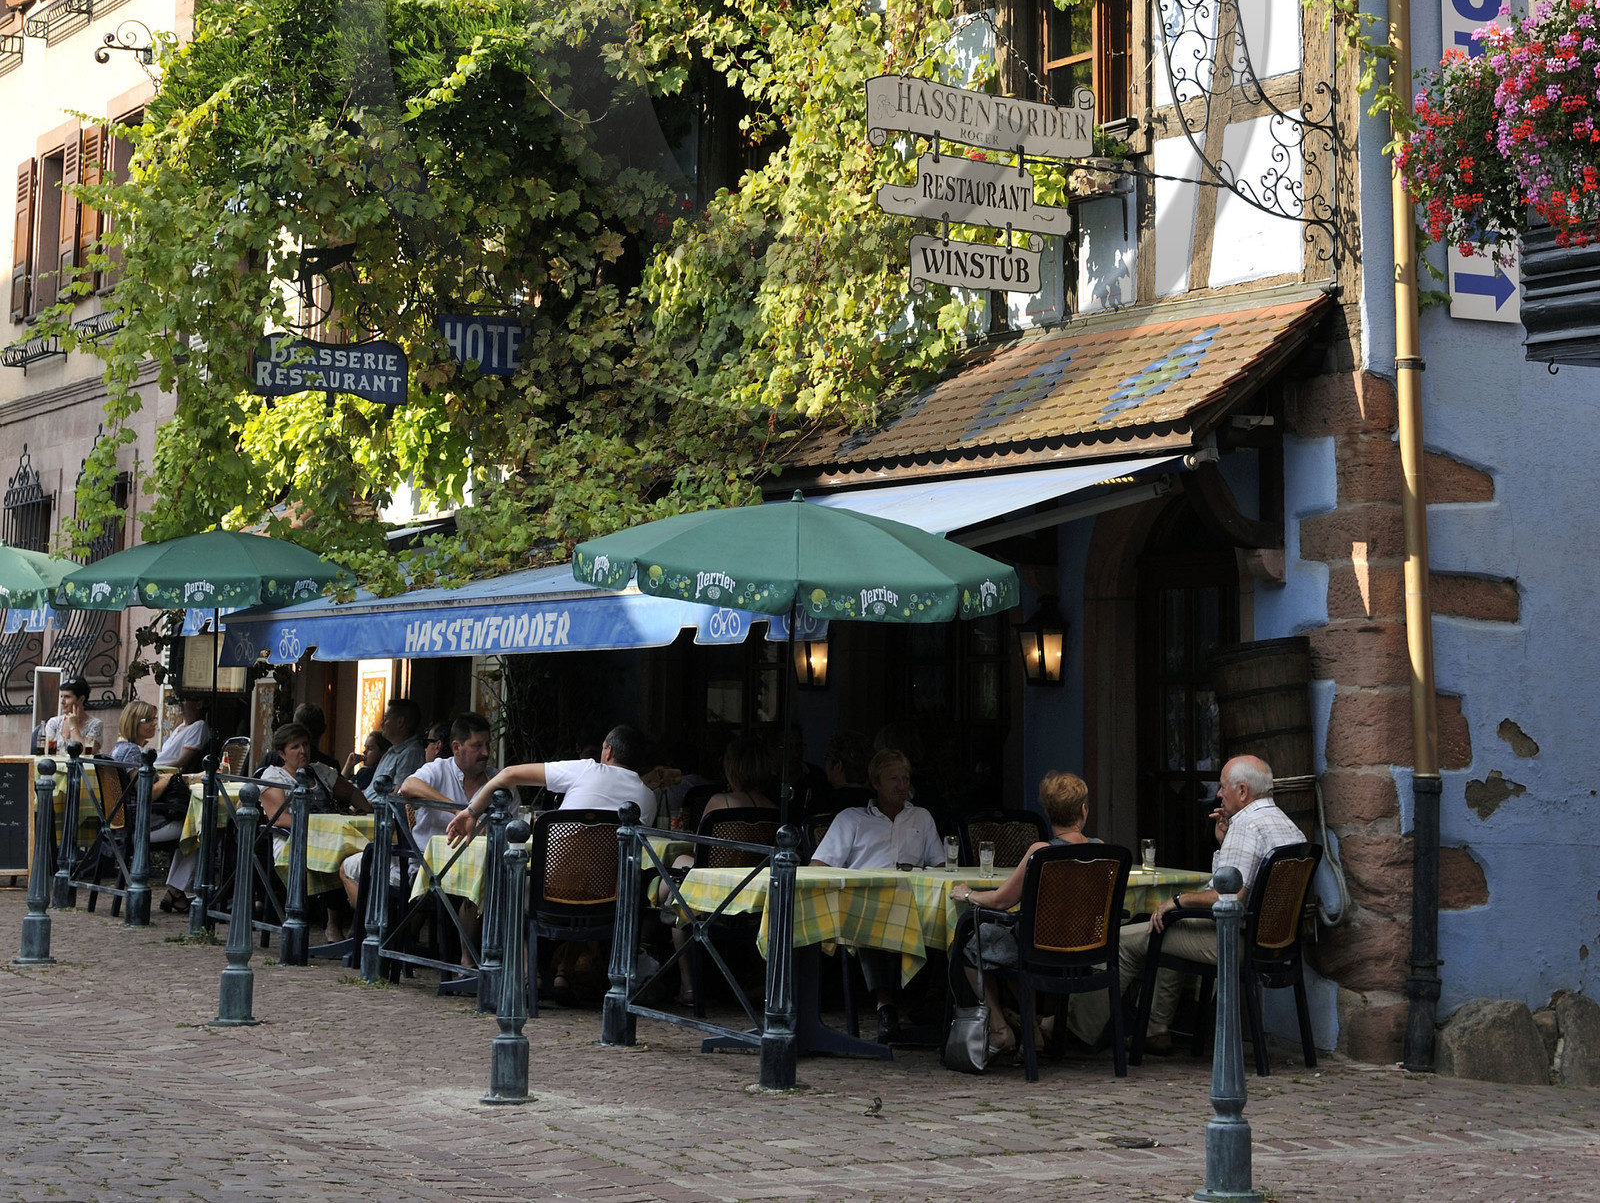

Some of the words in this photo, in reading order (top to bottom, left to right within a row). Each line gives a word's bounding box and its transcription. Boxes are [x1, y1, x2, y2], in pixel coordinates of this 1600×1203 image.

[896, 82, 1088, 142] HASSENFORDER
[960, 127, 999, 145] ROGER
[922, 172, 1031, 212] RESTAURANT
[920, 247, 1030, 283] WINSTUB
[444, 321, 532, 369] HOTE
[256, 361, 402, 393] RESTAURANT
[405, 610, 571, 652] HASSENFORDER
